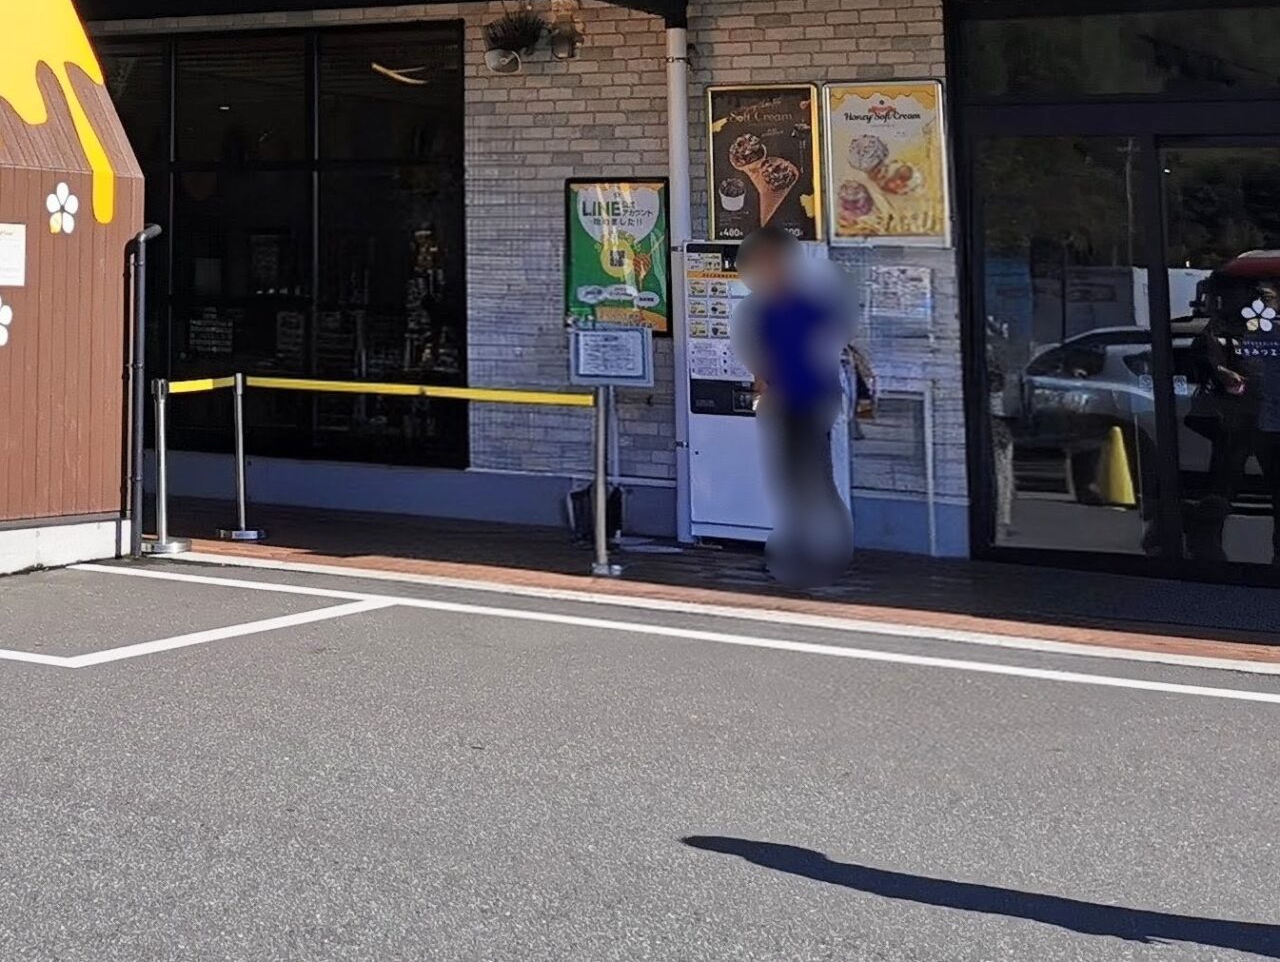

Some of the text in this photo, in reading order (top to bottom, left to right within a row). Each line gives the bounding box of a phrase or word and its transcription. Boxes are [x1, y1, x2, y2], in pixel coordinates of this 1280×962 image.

[754, 110, 794, 122] Cream
[844, 111, 921, 123] Honey Soft Cream
[582, 201, 621, 216] LINE
